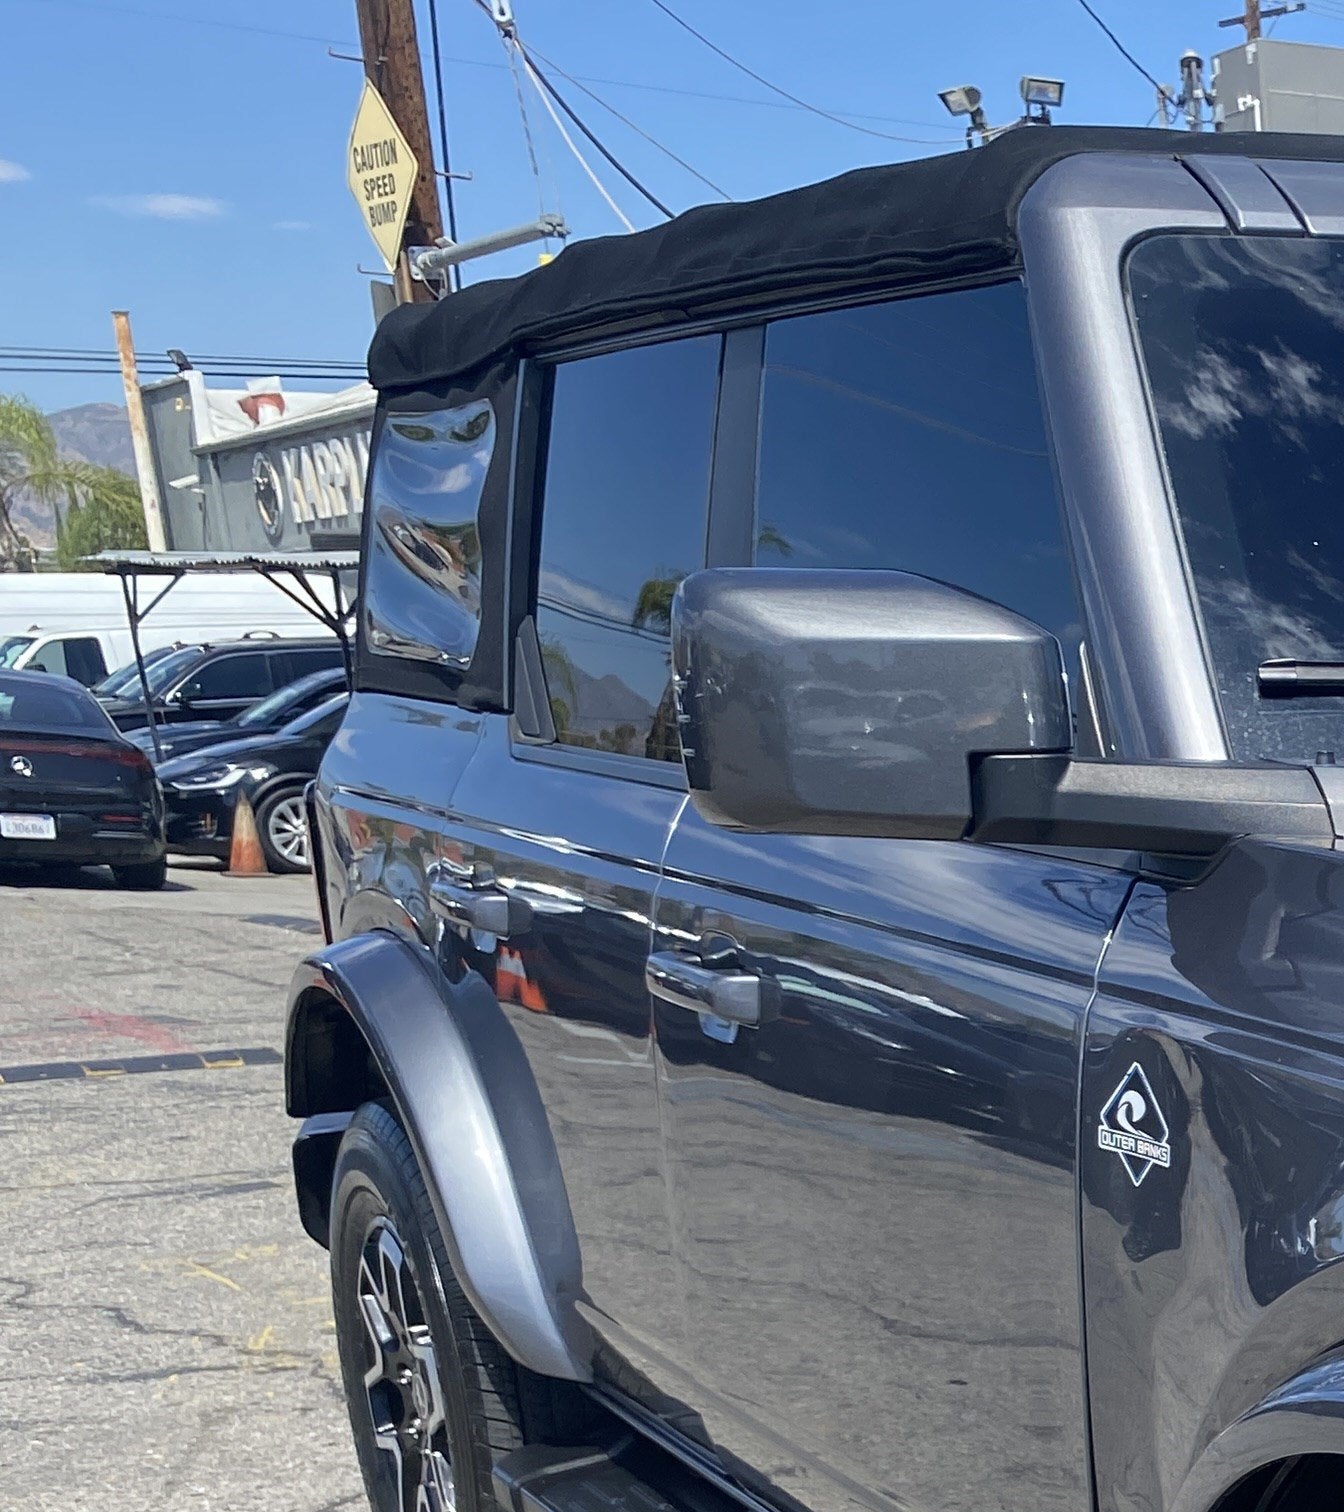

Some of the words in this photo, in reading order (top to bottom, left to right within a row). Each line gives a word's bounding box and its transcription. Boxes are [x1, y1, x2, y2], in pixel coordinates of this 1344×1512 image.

[353, 138, 398, 174] CAUTION
[363, 173, 396, 201] SPEED
[368, 200, 398, 227] BUMP
[1102, 1131, 1136, 1152] OUTER
[1136, 1141, 1168, 1161] BANKS
